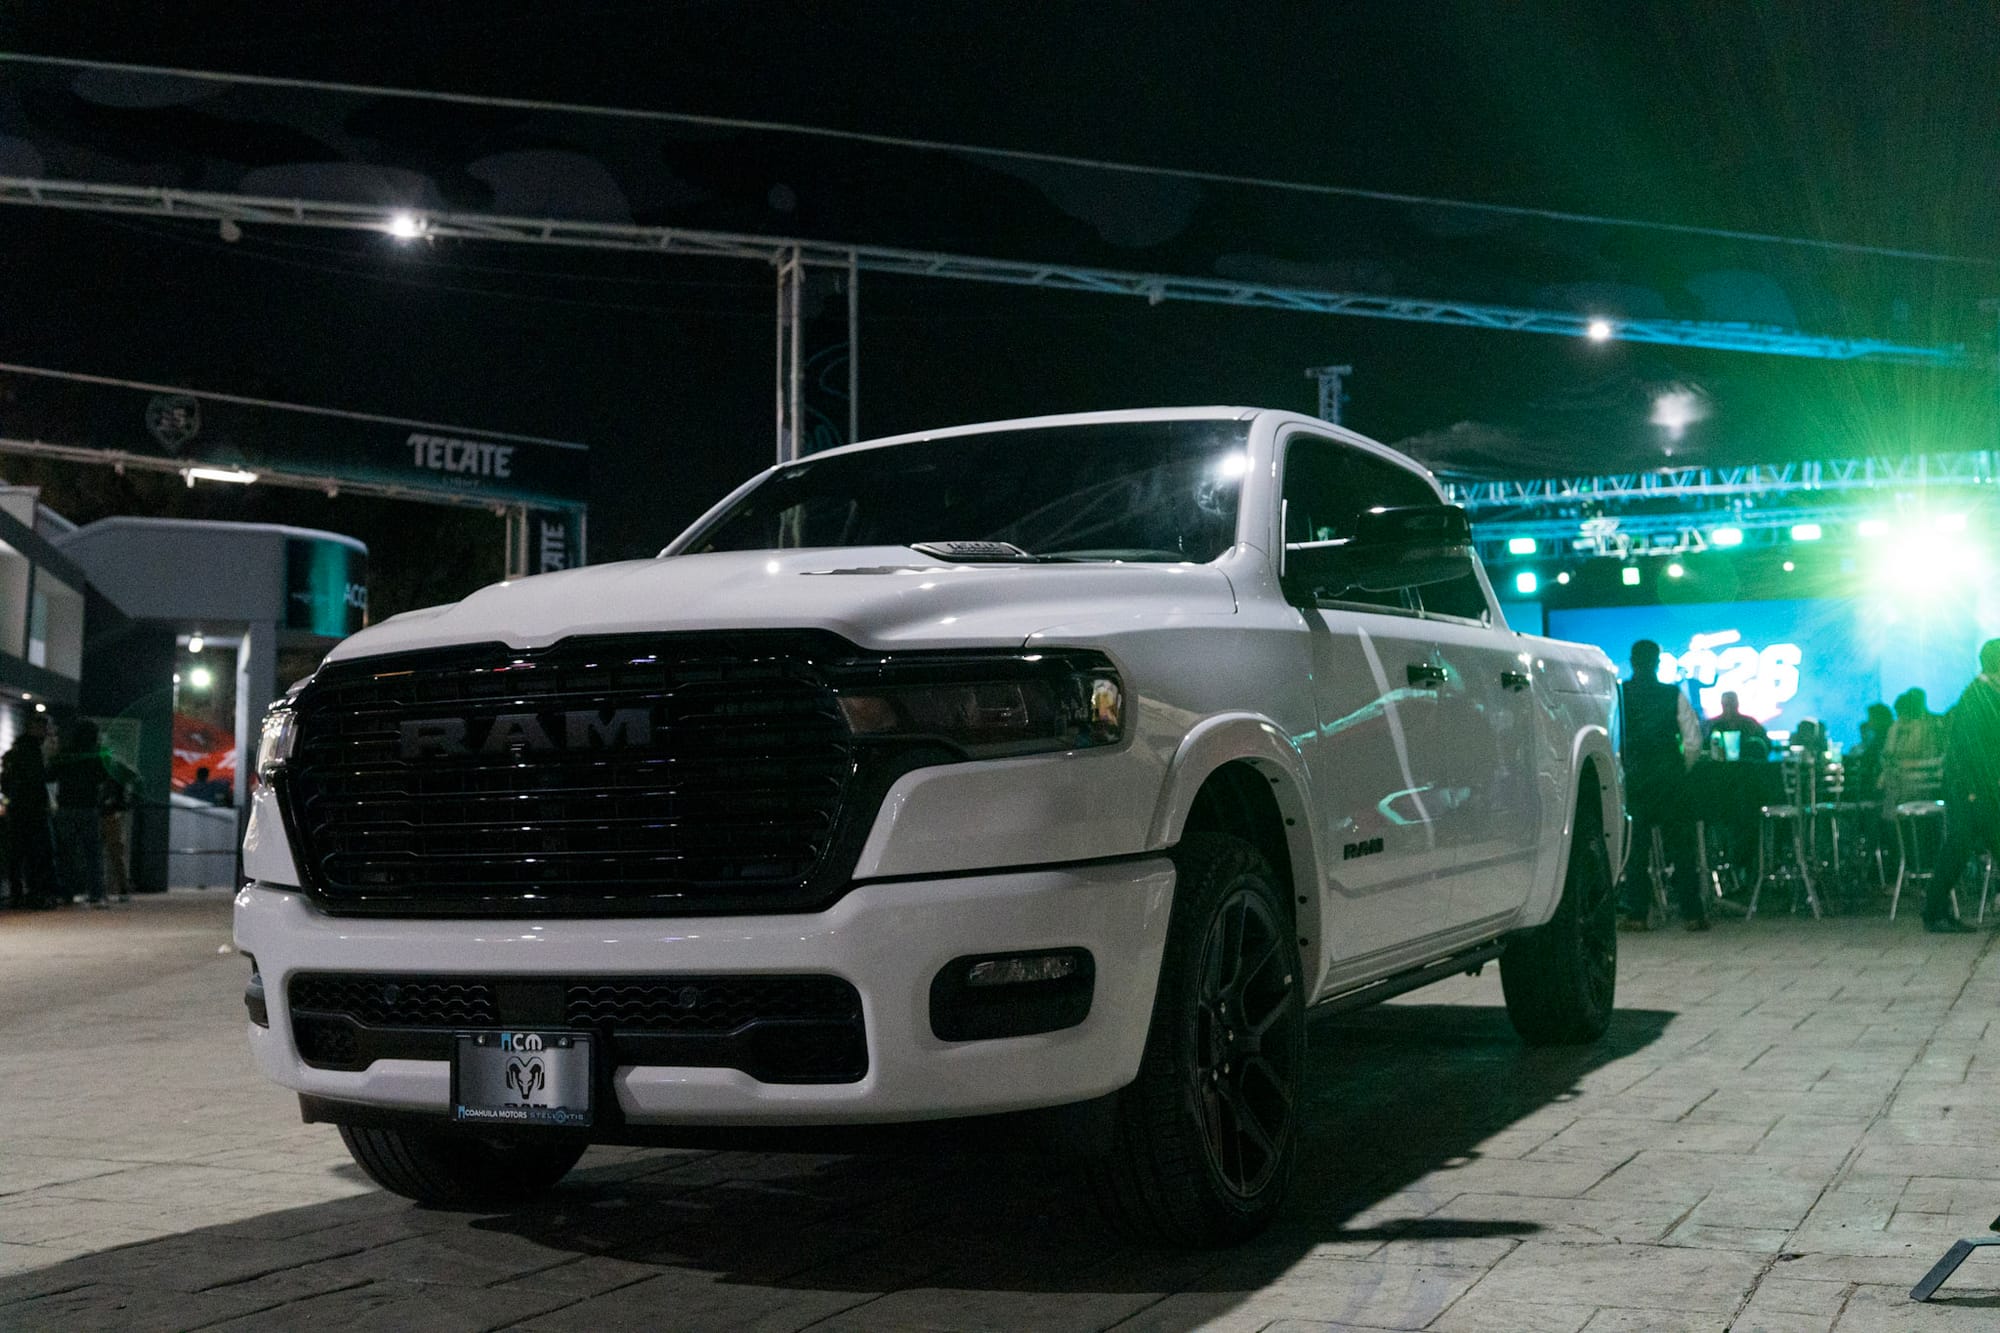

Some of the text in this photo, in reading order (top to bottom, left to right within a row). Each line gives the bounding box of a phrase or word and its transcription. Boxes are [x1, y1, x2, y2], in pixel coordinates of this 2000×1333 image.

[406, 433, 514, 478] TECATE
[399, 707, 654, 758] RAM
[1344, 837, 1384, 860] RAM
[464, 1108, 498, 1118] COAHUILA
[498, 1110, 528, 1119] MOTORS
